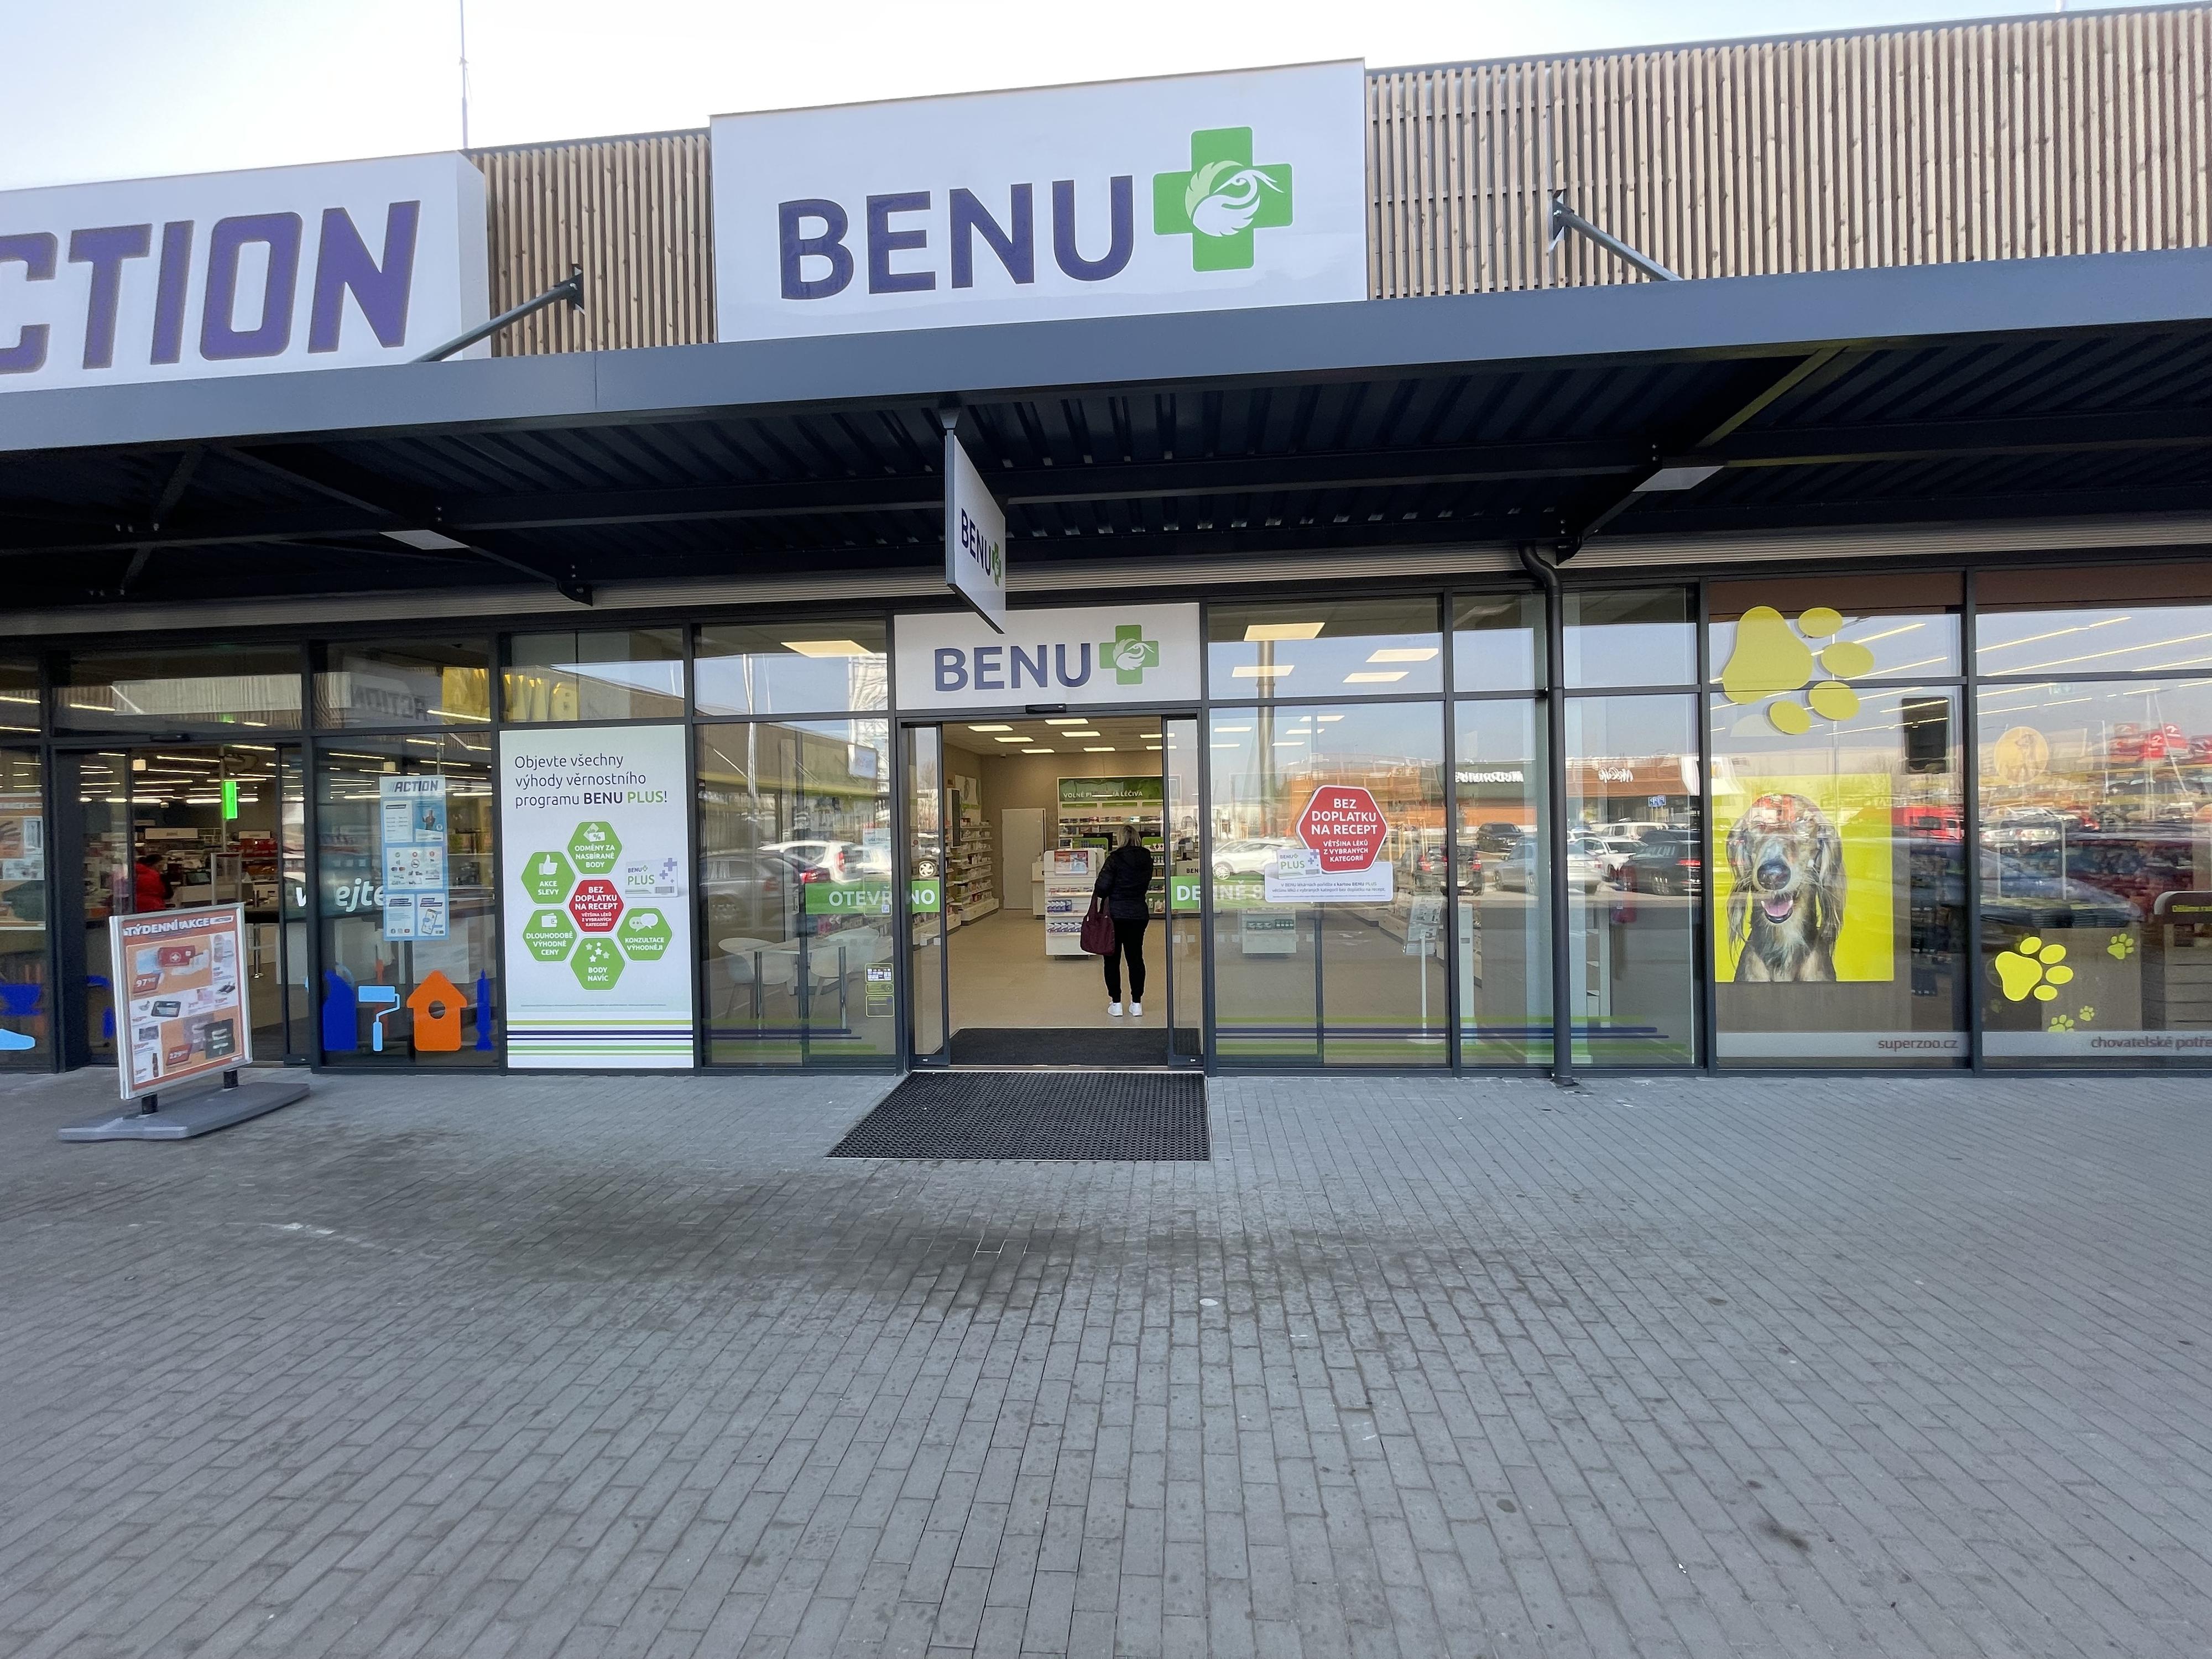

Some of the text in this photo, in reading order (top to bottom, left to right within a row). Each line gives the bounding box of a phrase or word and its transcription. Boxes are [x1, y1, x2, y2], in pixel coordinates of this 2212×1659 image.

[778, 174, 1134, 300] BENU
[0, 200, 421, 374] CTION
[961, 508, 991, 576] BENU
[935, 643, 1091, 691] BENU
[514, 753, 624, 770] Objevte všechny
[394, 780, 439, 792] ACTION
[515, 771, 646, 790] výhody věrnostního
[515, 791, 667, 808] programu BENU PLUS!
[1333, 798, 1357, 809] BEZ
[1311, 811, 1377, 822] DOPLATKU
[1311, 825, 1378, 835] NA RECEPT
[575, 843, 604, 852] ODMĚNY
[1323, 839, 1352, 847] VĚTŠINA
[575, 852, 615, 860] NASBÍRANÉ
[1329, 847, 1369, 855] VYBRANÝCH
[1281, 860, 1305, 870] PLUS
[628, 875, 655, 885] PLUS
[295, 878, 388, 912] vejte
[829, 886, 936, 906] OTEVŘNO
[526, 931, 573, 940] DLOUHODOBĚ
[1878, 1037, 1959, 1052] superzoo.cz
[2091, 1036, 2212, 1051] chovatelské potře
